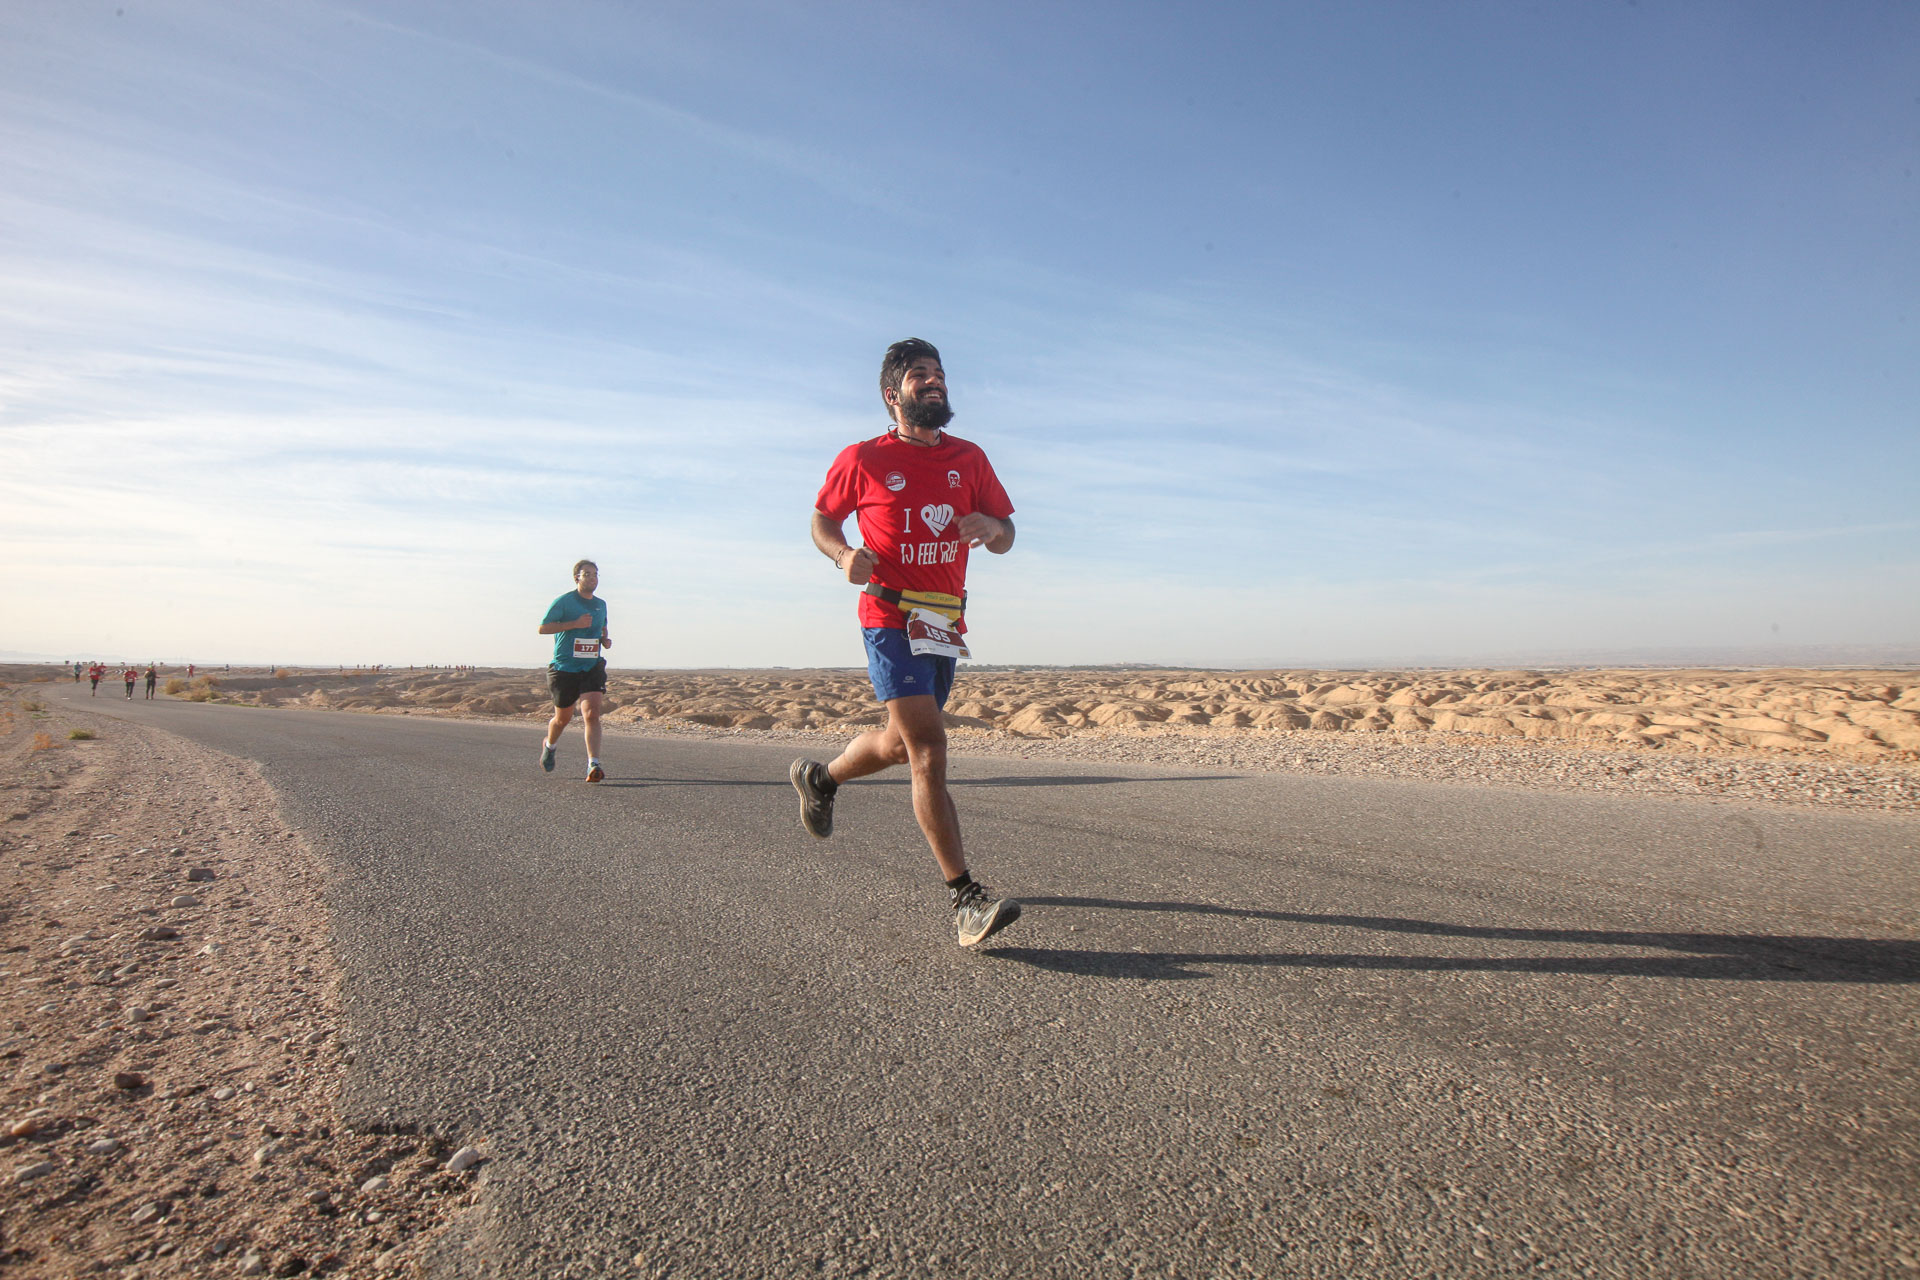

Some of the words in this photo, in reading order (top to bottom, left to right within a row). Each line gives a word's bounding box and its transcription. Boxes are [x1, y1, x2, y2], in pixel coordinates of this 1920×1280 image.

[903, 508, 912, 533] I
[917, 542, 938, 566] FEEL
[924, 624, 951, 643] 155
